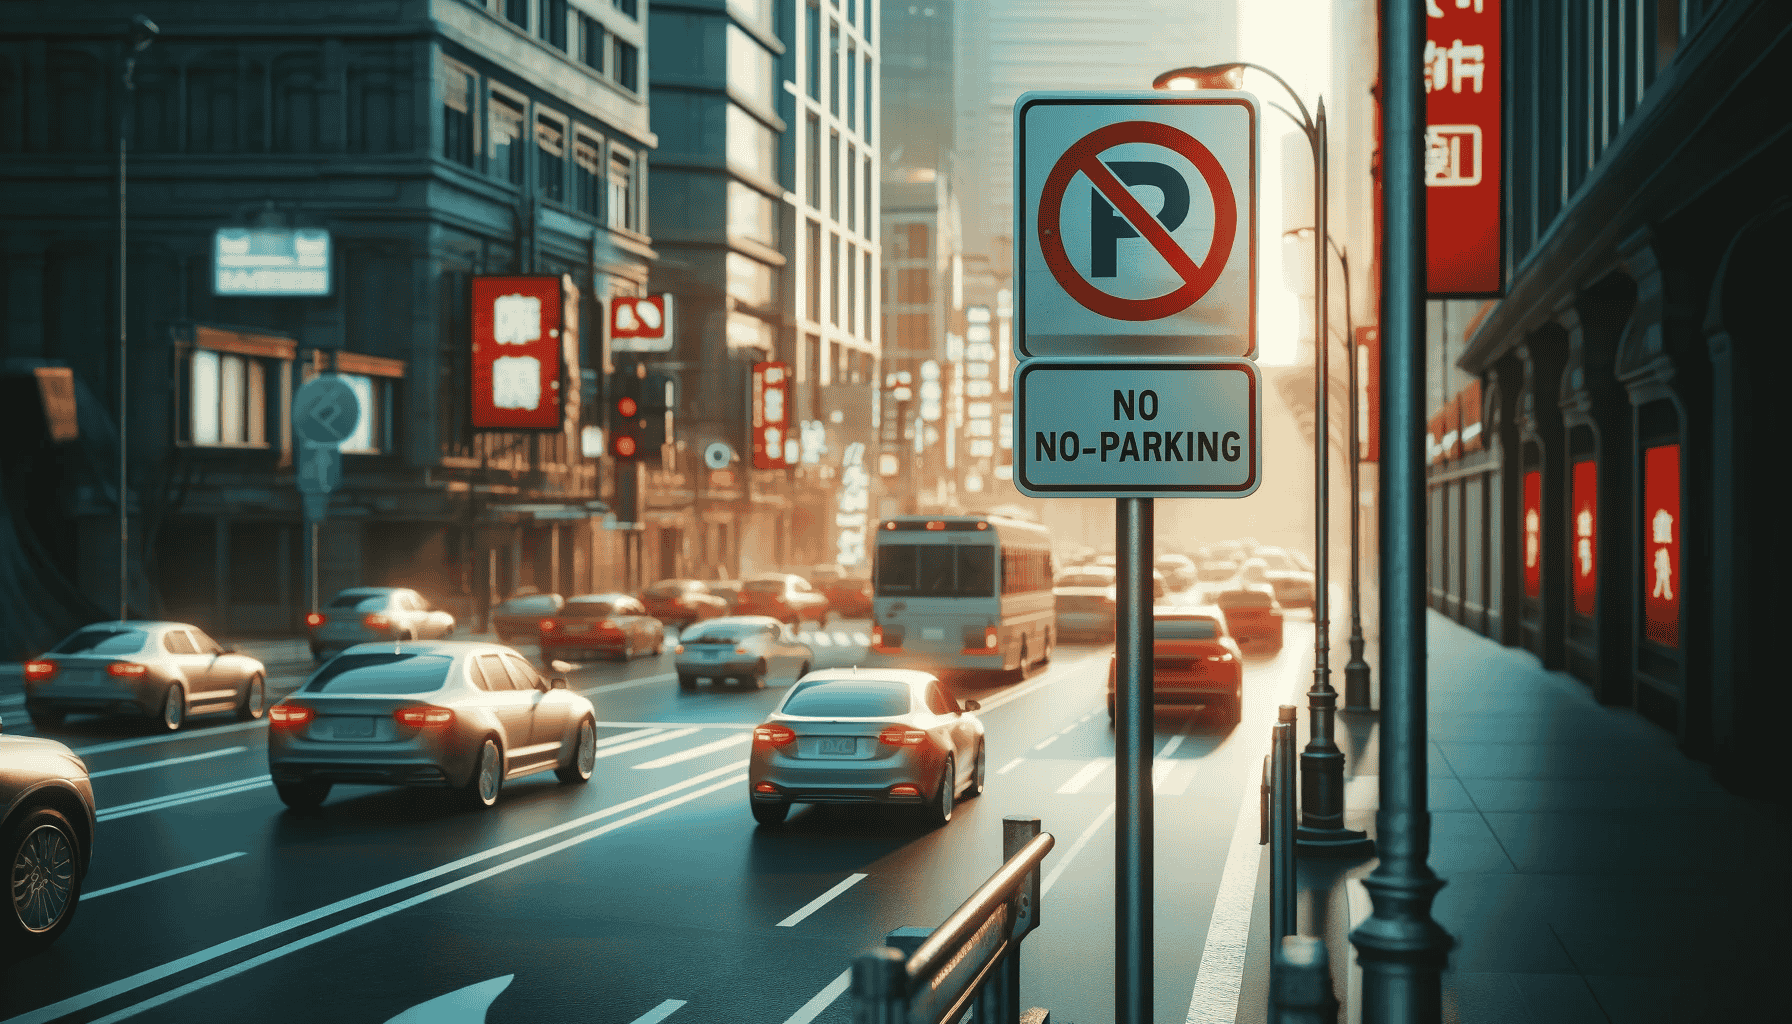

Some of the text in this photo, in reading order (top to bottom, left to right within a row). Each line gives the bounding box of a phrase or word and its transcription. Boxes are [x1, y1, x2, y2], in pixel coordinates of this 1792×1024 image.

[1091, 161, 1190, 278] P
[1113, 389, 1159, 421] NO
[1035, 431, 1241, 463] NO-PARKING
